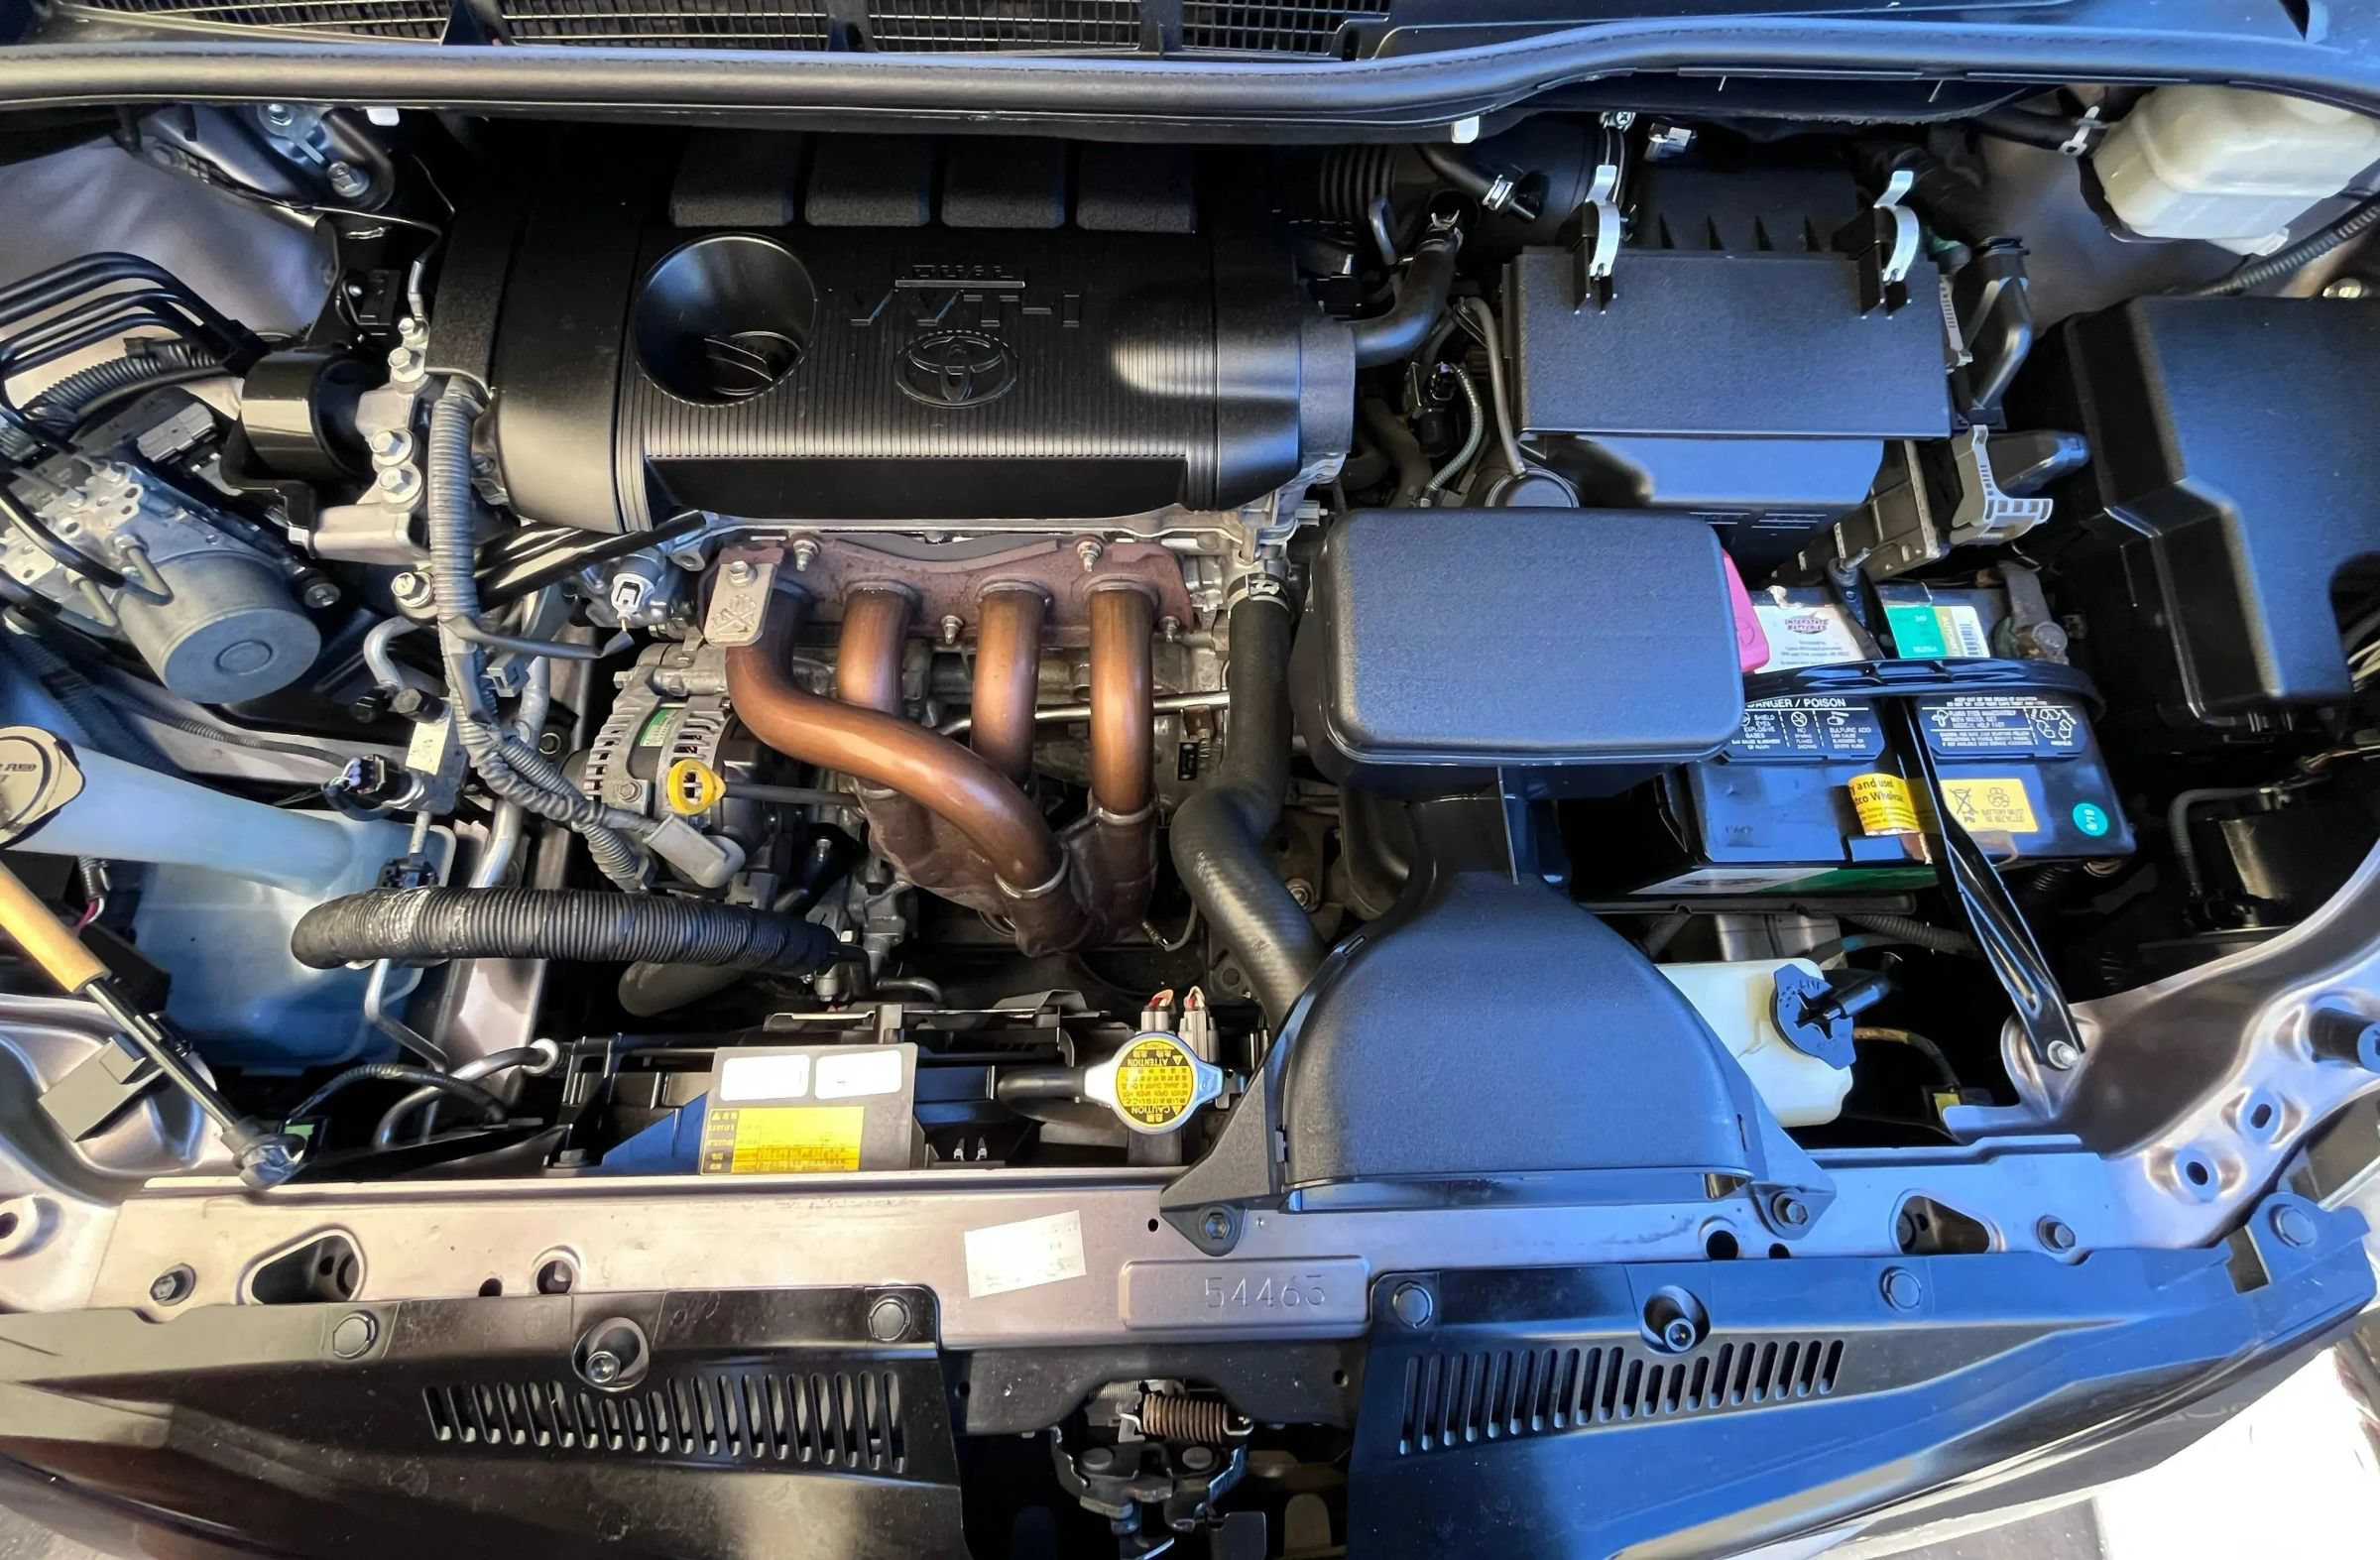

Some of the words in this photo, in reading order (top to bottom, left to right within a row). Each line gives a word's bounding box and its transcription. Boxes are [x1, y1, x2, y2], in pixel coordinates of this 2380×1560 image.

[1803, 697, 1846, 707] POISON
[1856, 778, 1877, 790] and
[1127, 1057, 1168, 1066] ATTENTION
